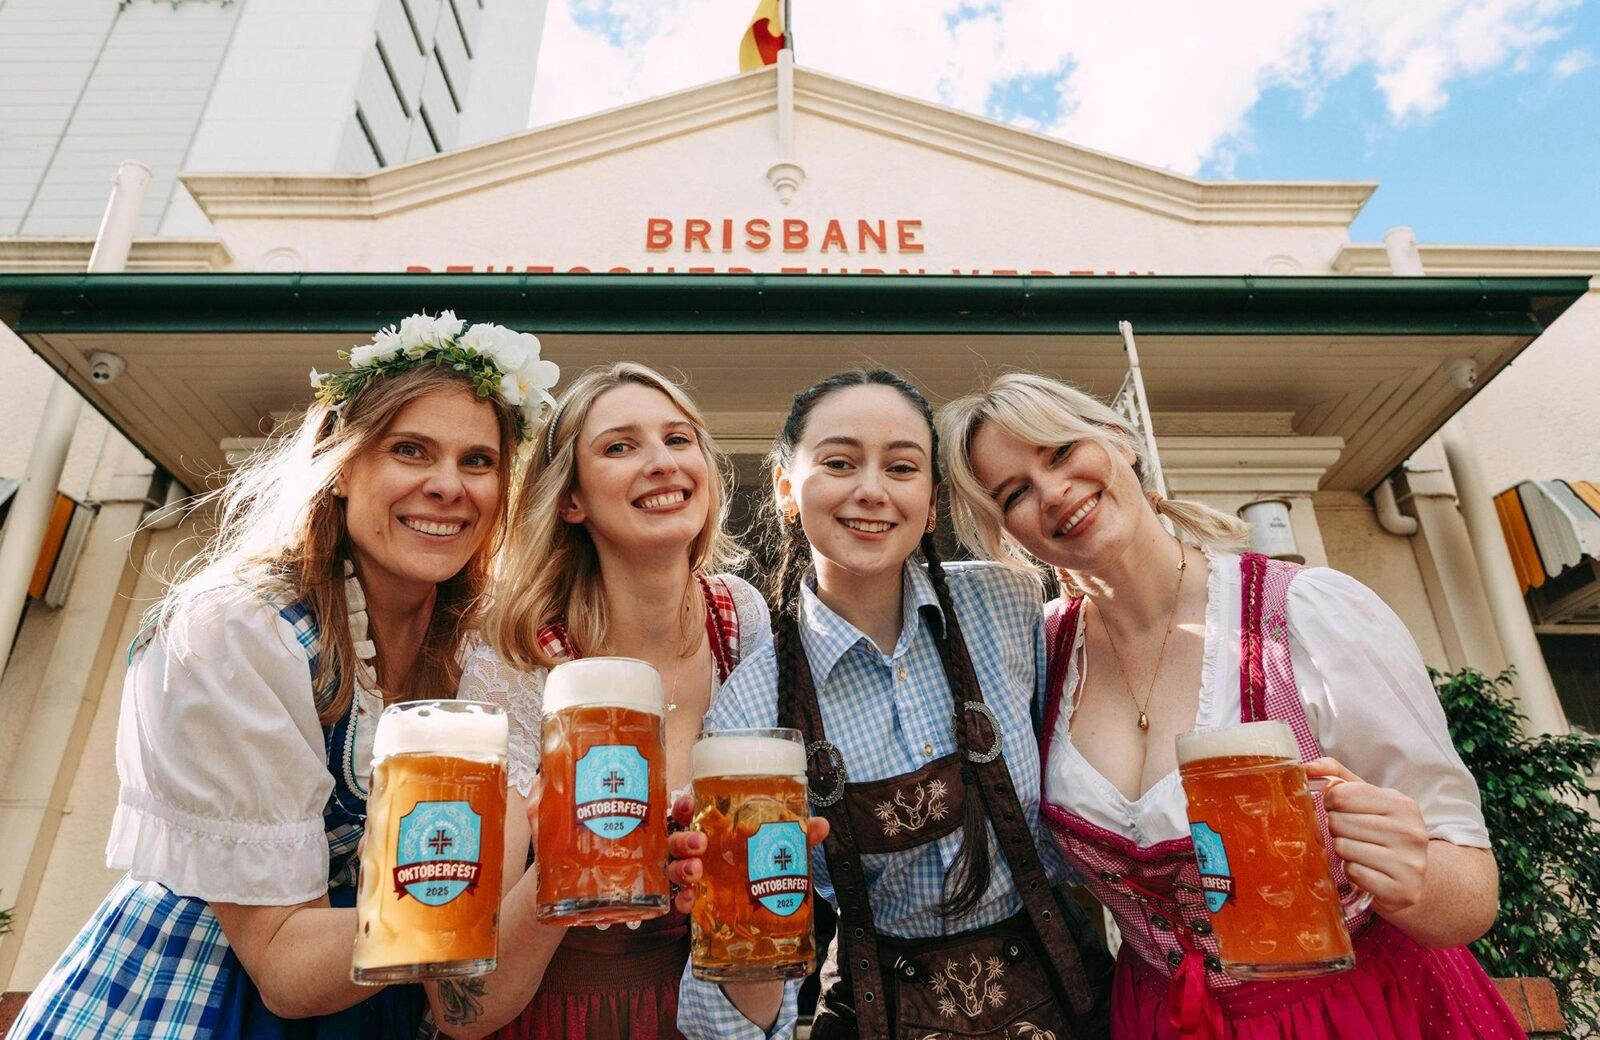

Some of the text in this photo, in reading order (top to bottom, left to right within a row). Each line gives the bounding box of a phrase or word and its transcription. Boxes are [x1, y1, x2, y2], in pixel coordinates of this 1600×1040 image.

[646, 218, 925, 252] BRISBANE
[576, 800, 648, 819] OKTOBERFEST
[603, 822, 625, 831] 2025
[397, 863, 478, 883] OKTOBERFEST
[425, 886, 449, 896] 2025
[751, 878, 808, 896] OKTOBERFEST
[777, 898, 794, 908] 2025
